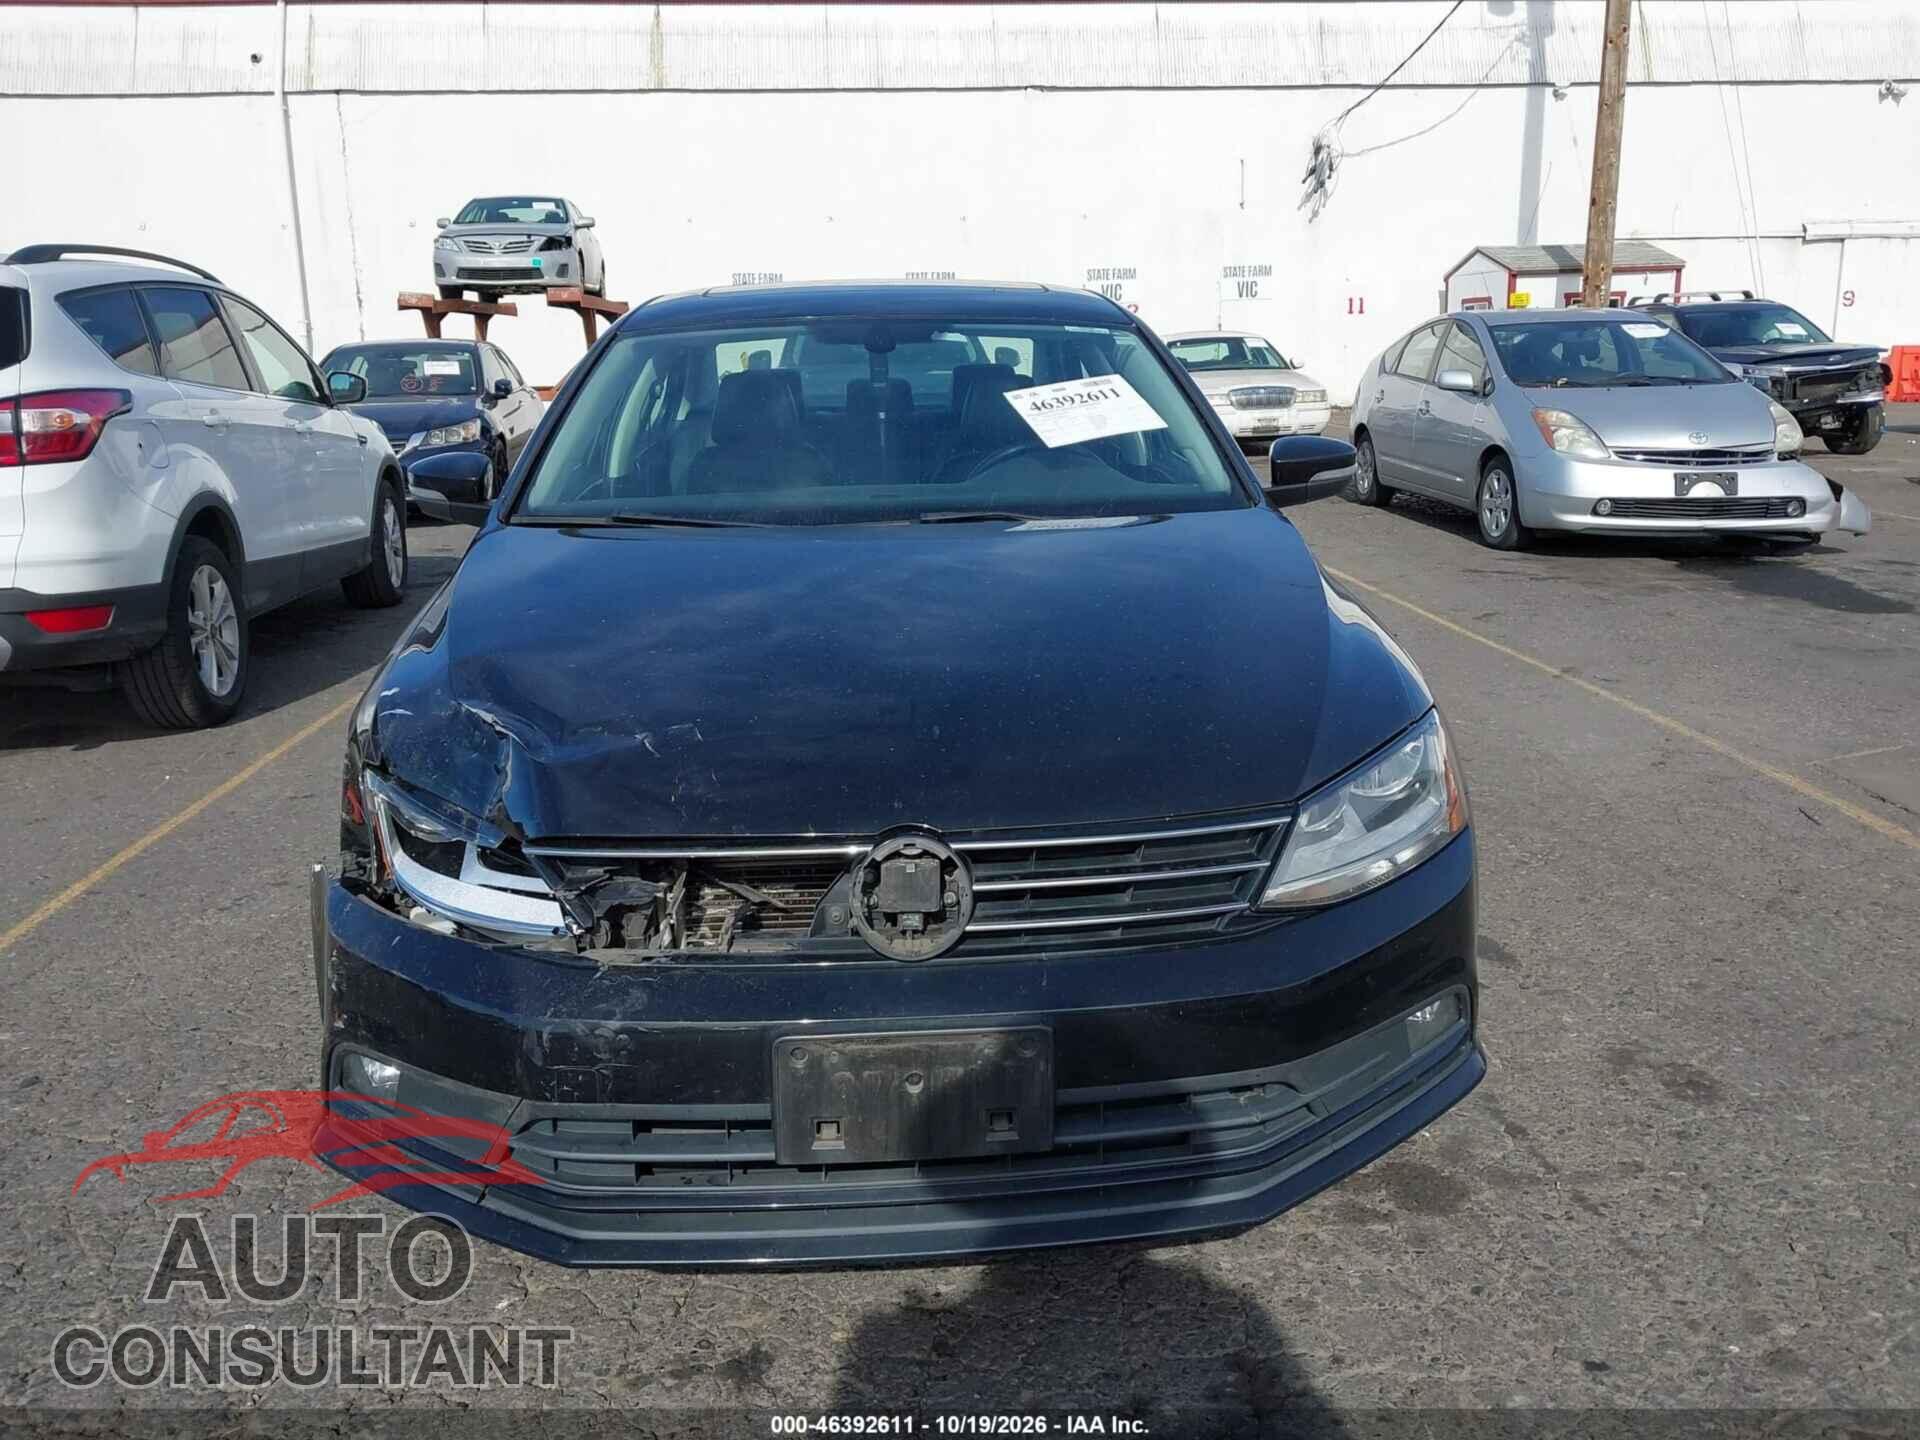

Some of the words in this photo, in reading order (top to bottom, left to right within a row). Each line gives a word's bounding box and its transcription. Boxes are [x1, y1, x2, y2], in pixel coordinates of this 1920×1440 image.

[732, 272, 757, 286] STATE
[759, 272, 783, 285] FARM
[1087, 268, 1110, 281] STATE
[1112, 267, 1136, 280] FARM
[1223, 265, 1245, 278] STATE
[1248, 263, 1272, 277] FARM
[1101, 283, 1122, 301] VIC
[1237, 280, 1258, 298] VIC
[1347, 297, 1365, 314] 11
[1842, 290, 1855, 307] 9
[1029, 387, 1121, 412] 46392611
